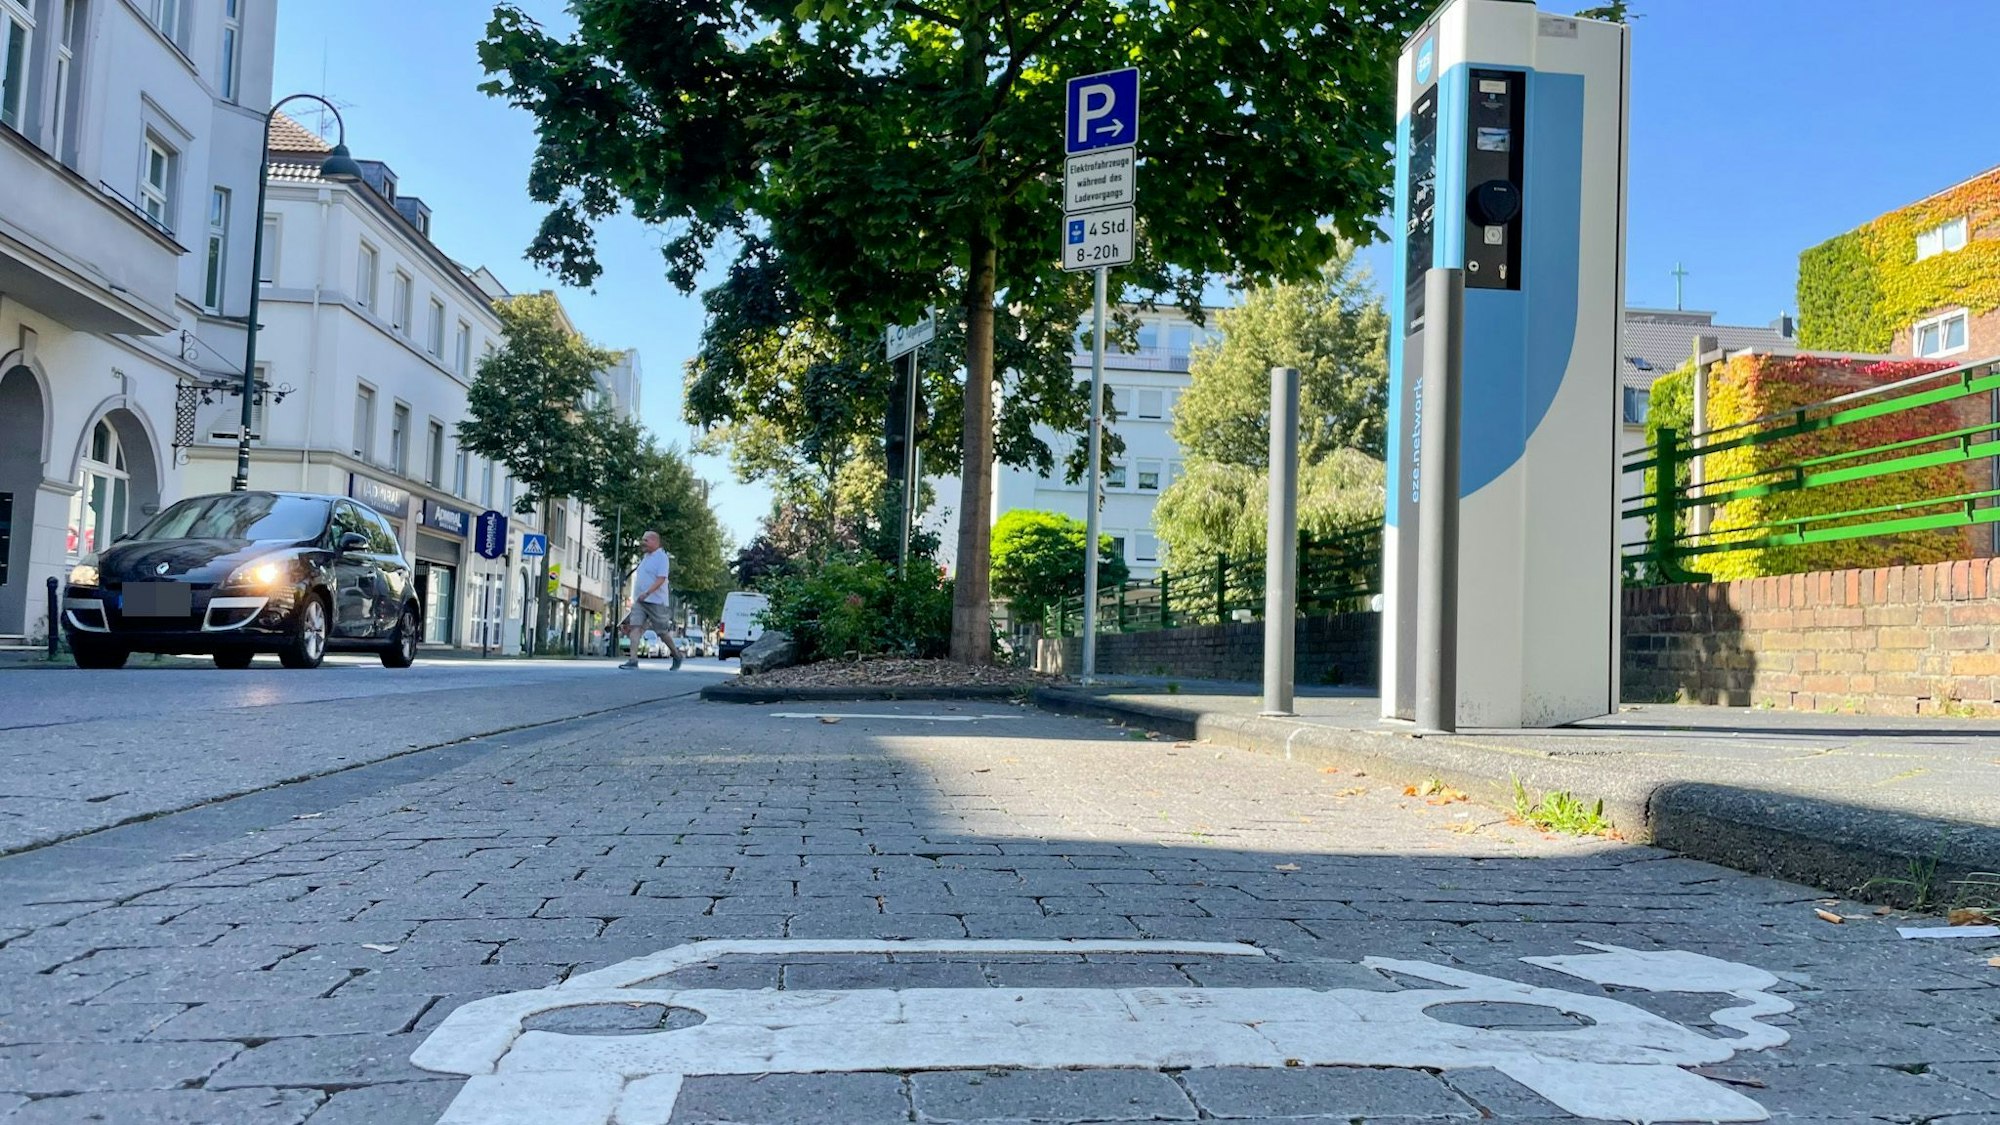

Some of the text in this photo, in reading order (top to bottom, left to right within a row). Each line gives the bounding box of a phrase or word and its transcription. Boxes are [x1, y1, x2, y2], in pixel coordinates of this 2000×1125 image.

[1078, 83, 1116, 143] P
[1070, 158, 1129, 174] Elektrofahrzeuge
[1077, 173, 1122, 188] während des
[1075, 189, 1123, 203] Ladevorgangs
[1089, 219, 1129, 236] 4 Std.
[1412, 376, 1423, 503] eze.network
[363, 480, 400, 507] ADMIRAL
[434, 505, 462, 528] ADMIRAL
[485, 513, 496, 556] ADMIRAL
